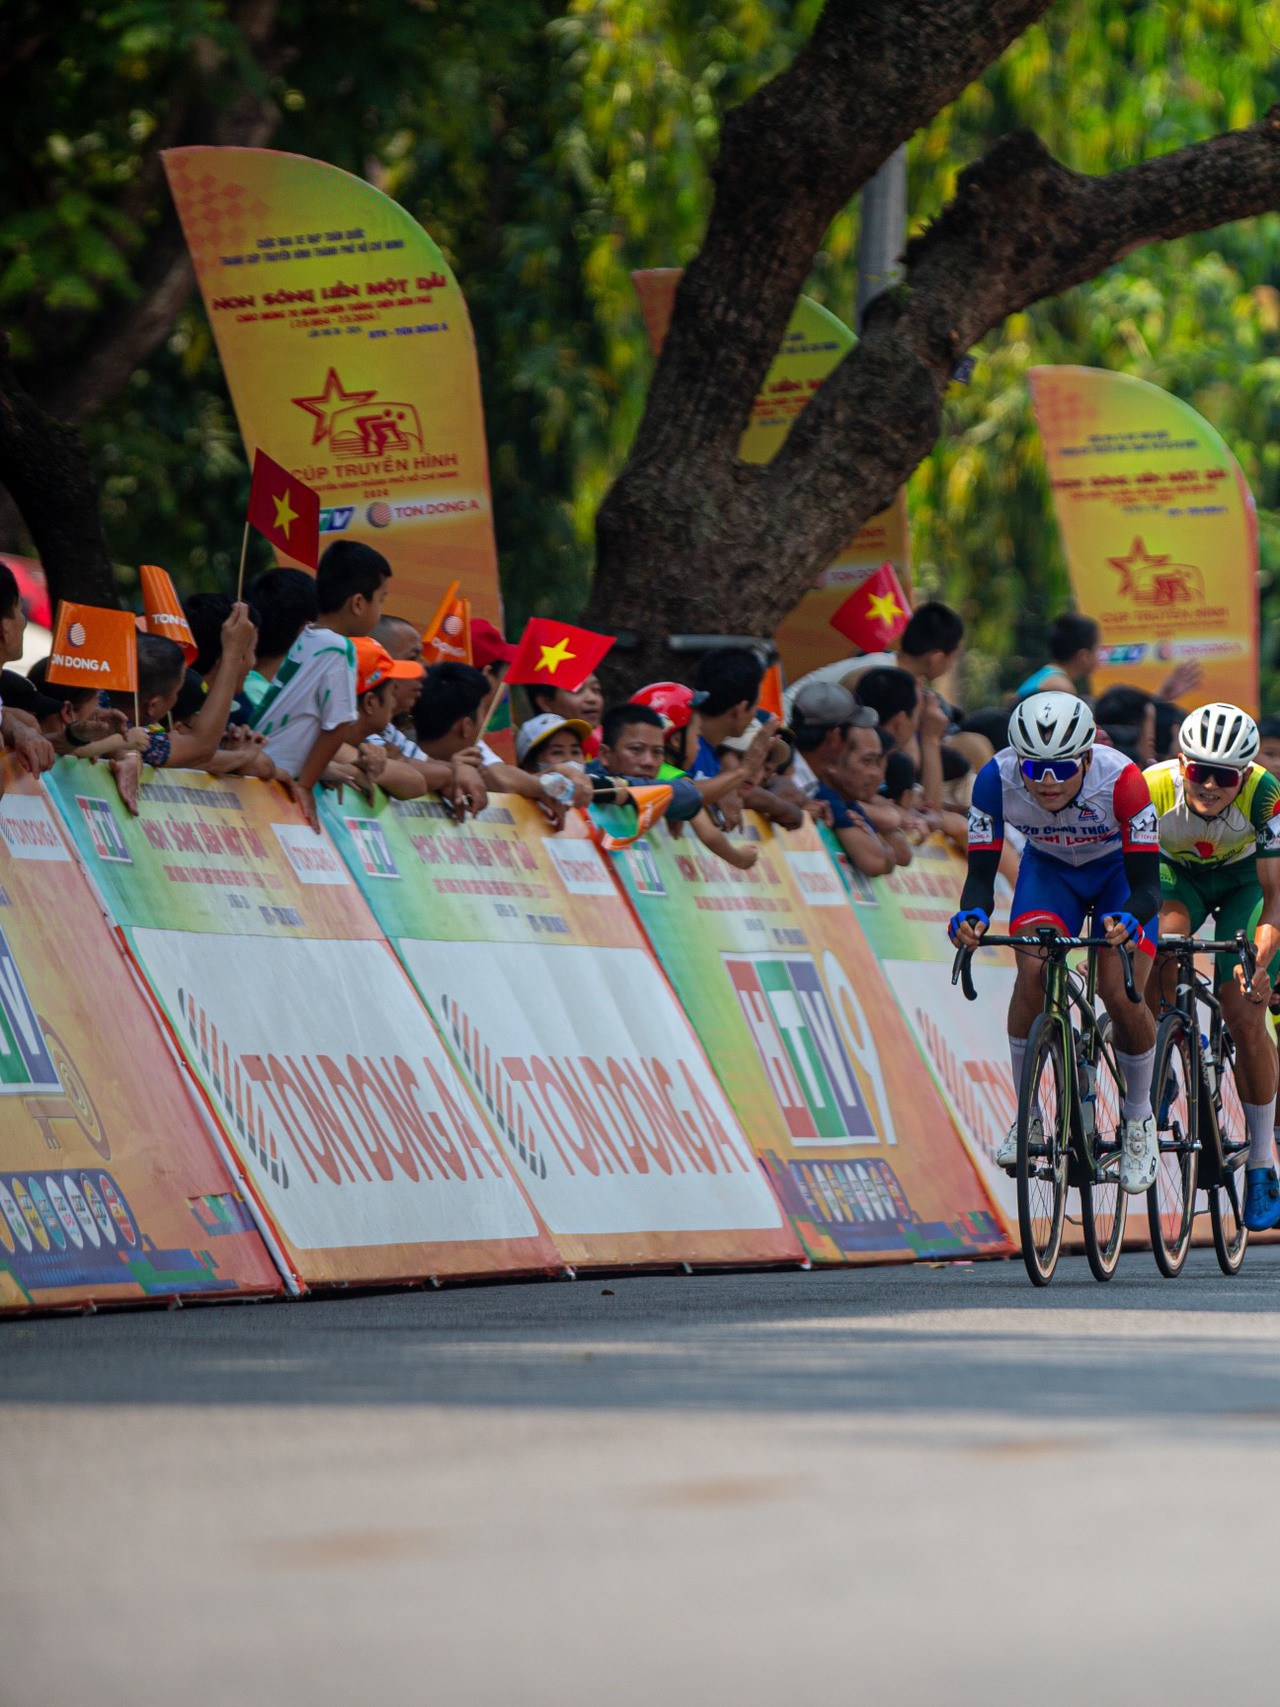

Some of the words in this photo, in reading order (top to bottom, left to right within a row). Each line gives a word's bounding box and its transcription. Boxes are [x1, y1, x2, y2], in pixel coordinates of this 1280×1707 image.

[213, 294, 255, 311] NON
[334, 455, 408, 478] TRUYỀN
[414, 452, 458, 469] HÌNH
[65, 656, 99, 671] DONG
[99, 660, 111, 673] A
[80, 805, 126, 852] HTV
[239, 1053, 373, 1186] TON
[316, 1053, 467, 1183] DONG
[423, 1056, 504, 1179] A
[501, 1054, 630, 1177] TON
[578, 1055, 718, 1176] DONG
[677, 1058, 750, 1174] A
